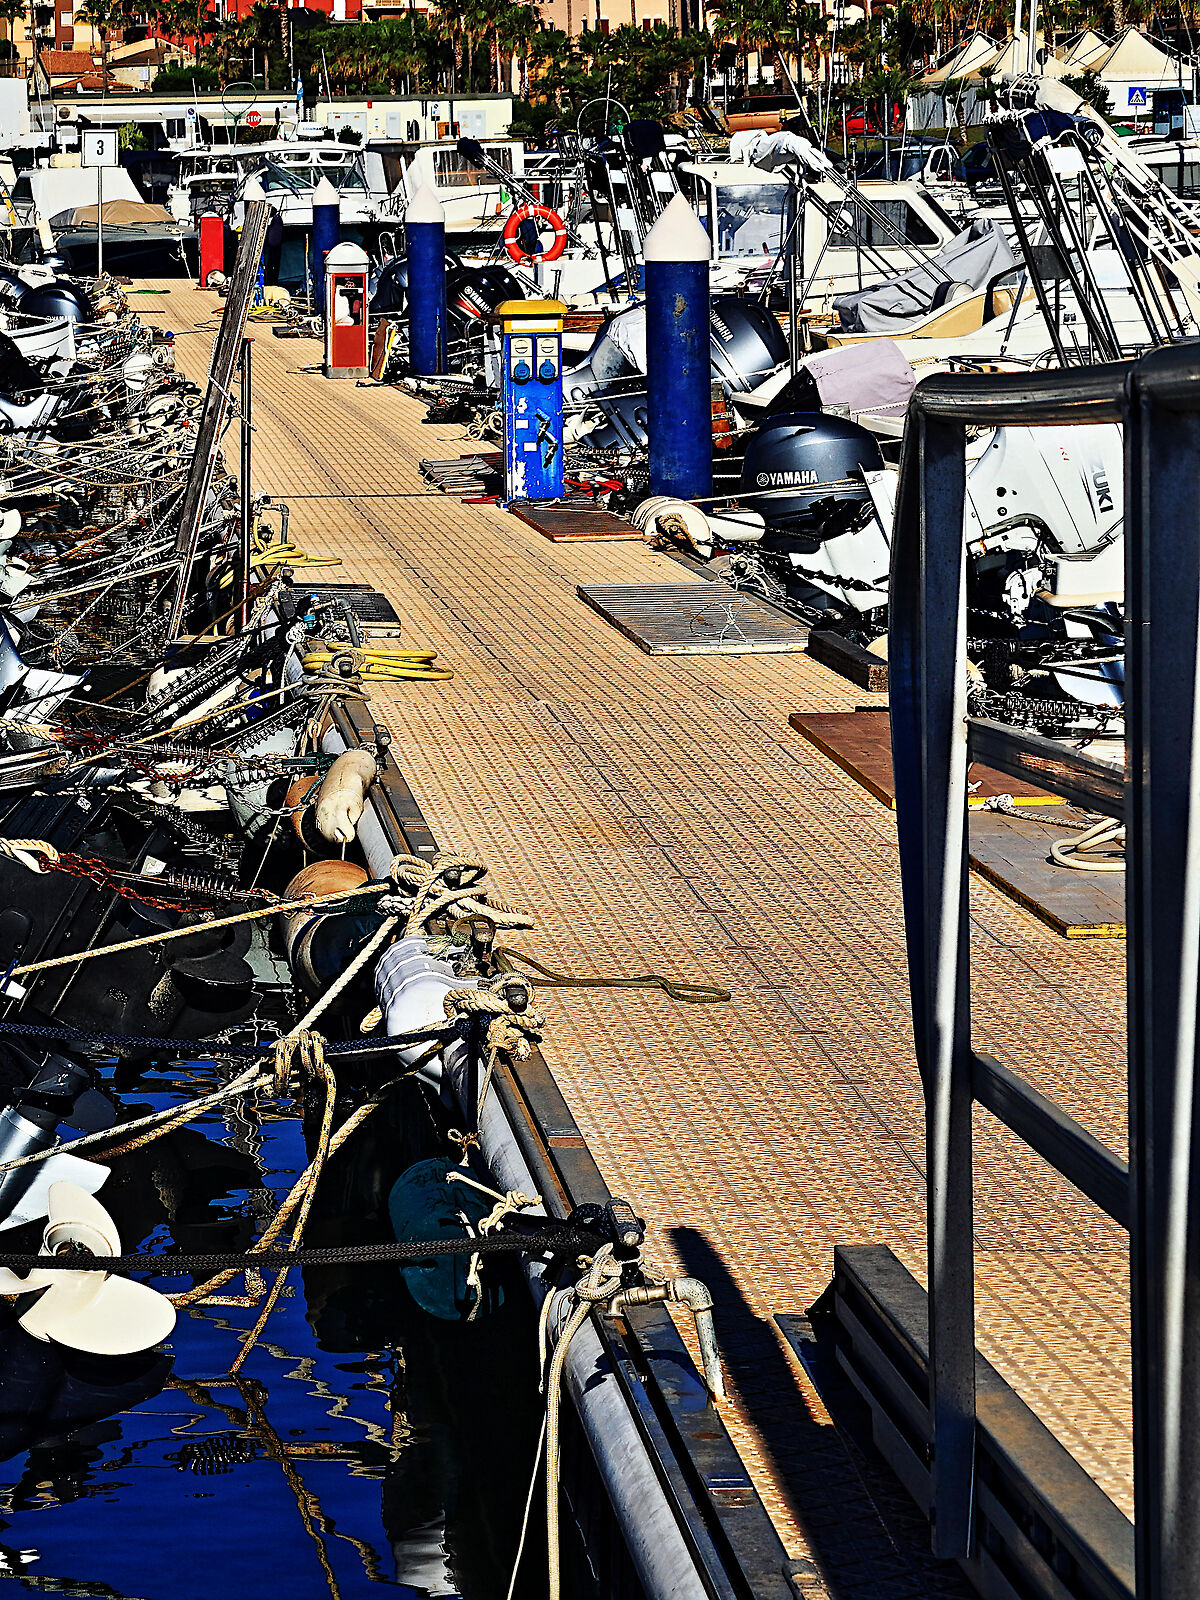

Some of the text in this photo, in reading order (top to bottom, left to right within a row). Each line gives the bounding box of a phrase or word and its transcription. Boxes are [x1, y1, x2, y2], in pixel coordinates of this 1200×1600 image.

[96, 139, 105, 156] 3
[709, 312, 735, 343] YAMAHA
[769, 469, 819, 486] YAMAHA
